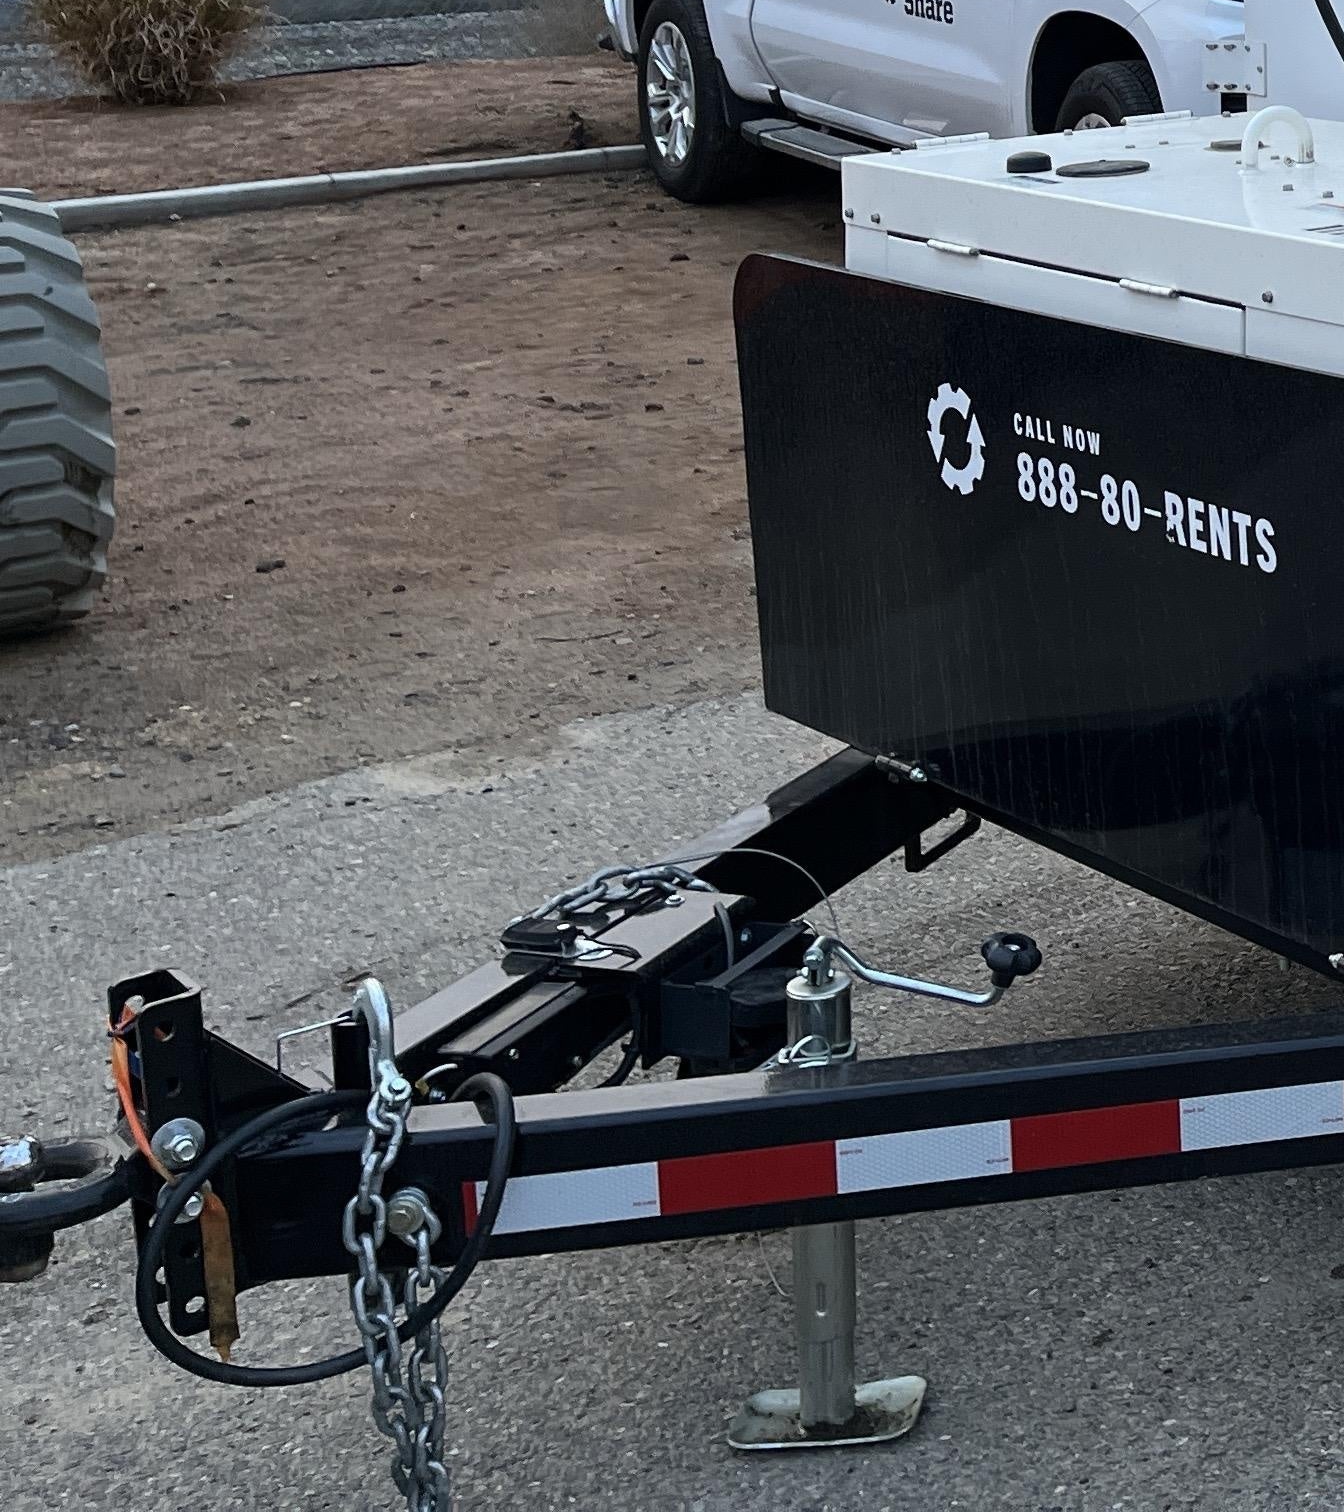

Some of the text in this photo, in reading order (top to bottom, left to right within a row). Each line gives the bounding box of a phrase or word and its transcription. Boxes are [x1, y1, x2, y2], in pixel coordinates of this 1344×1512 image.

[1013, 412, 1100, 456] CALL NOW
[1016, 451, 1278, 574] 888-80-RENTS
